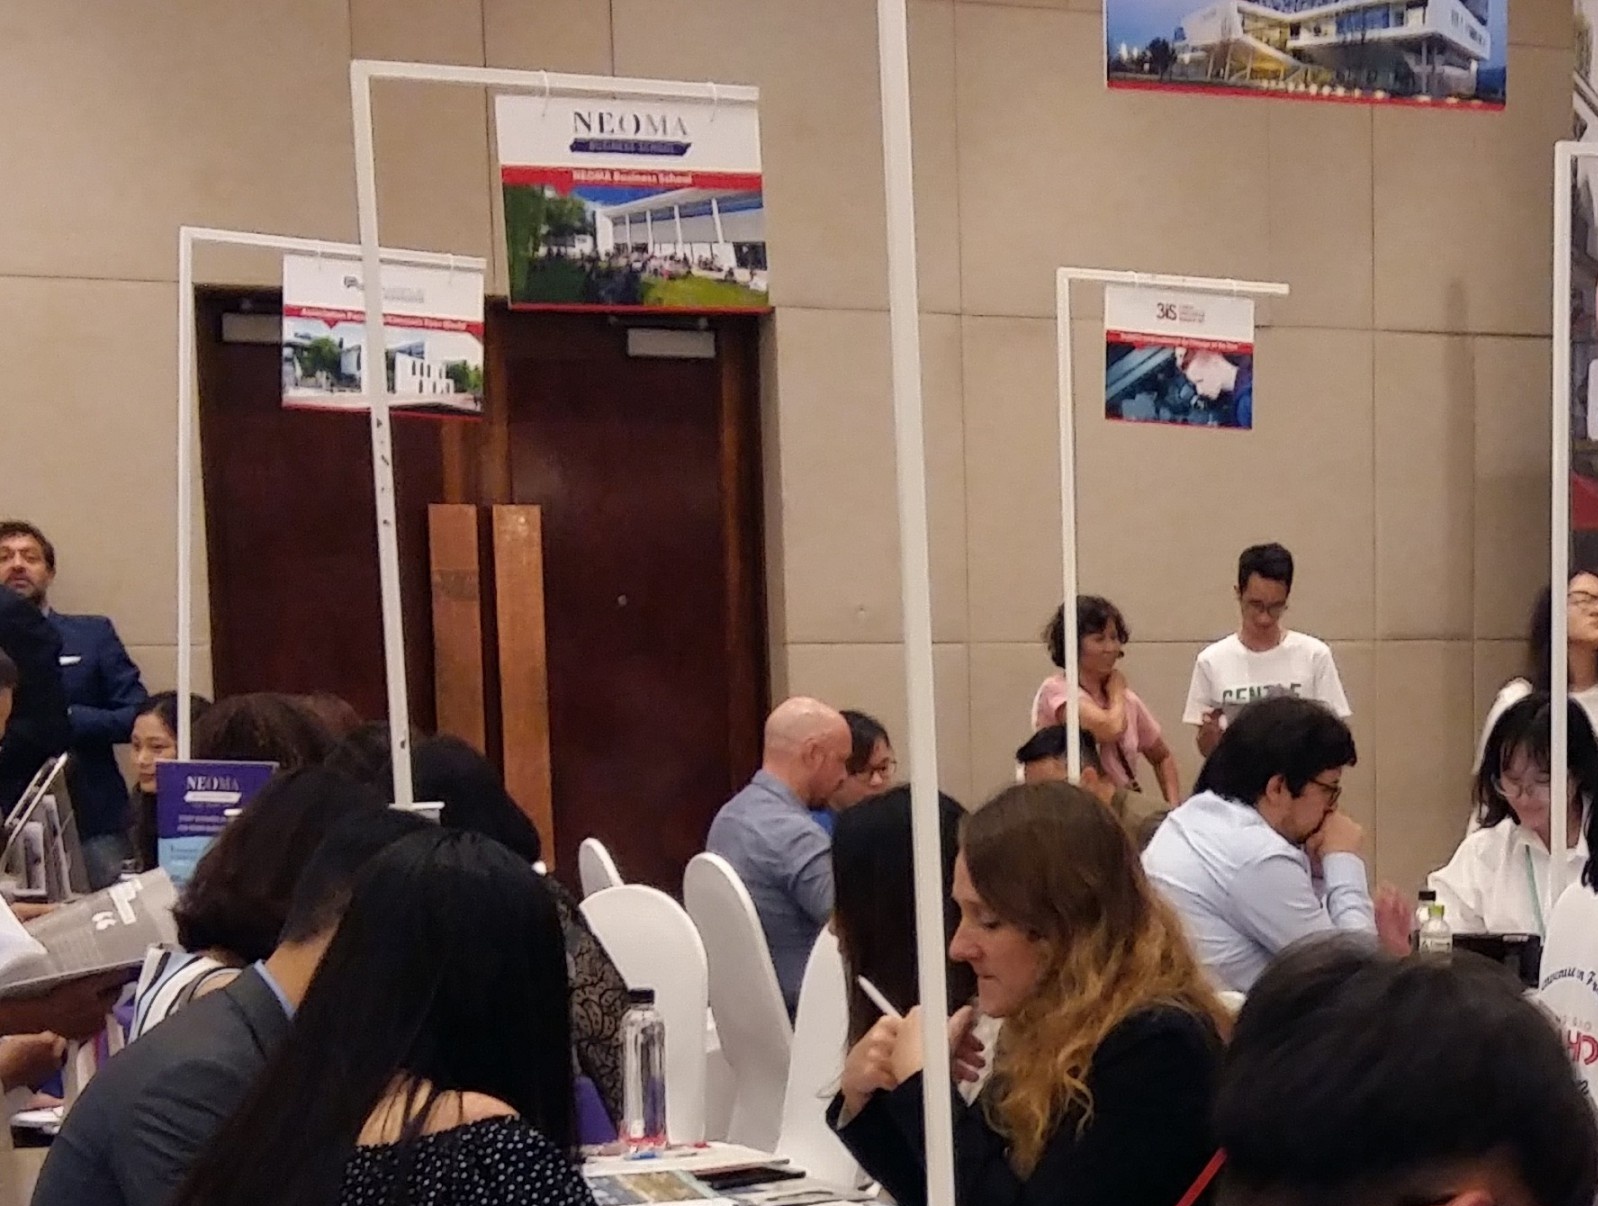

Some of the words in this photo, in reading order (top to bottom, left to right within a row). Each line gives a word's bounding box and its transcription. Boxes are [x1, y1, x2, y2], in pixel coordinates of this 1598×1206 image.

[573, 110, 689, 137] NEOMA
[572, 170, 612, 182] NEOMA
[613, 171, 658, 183] Business
[659, 172, 693, 184] School
[1222, 682, 1302, 701] GENTE
[186, 775, 240, 791] NEOMA
